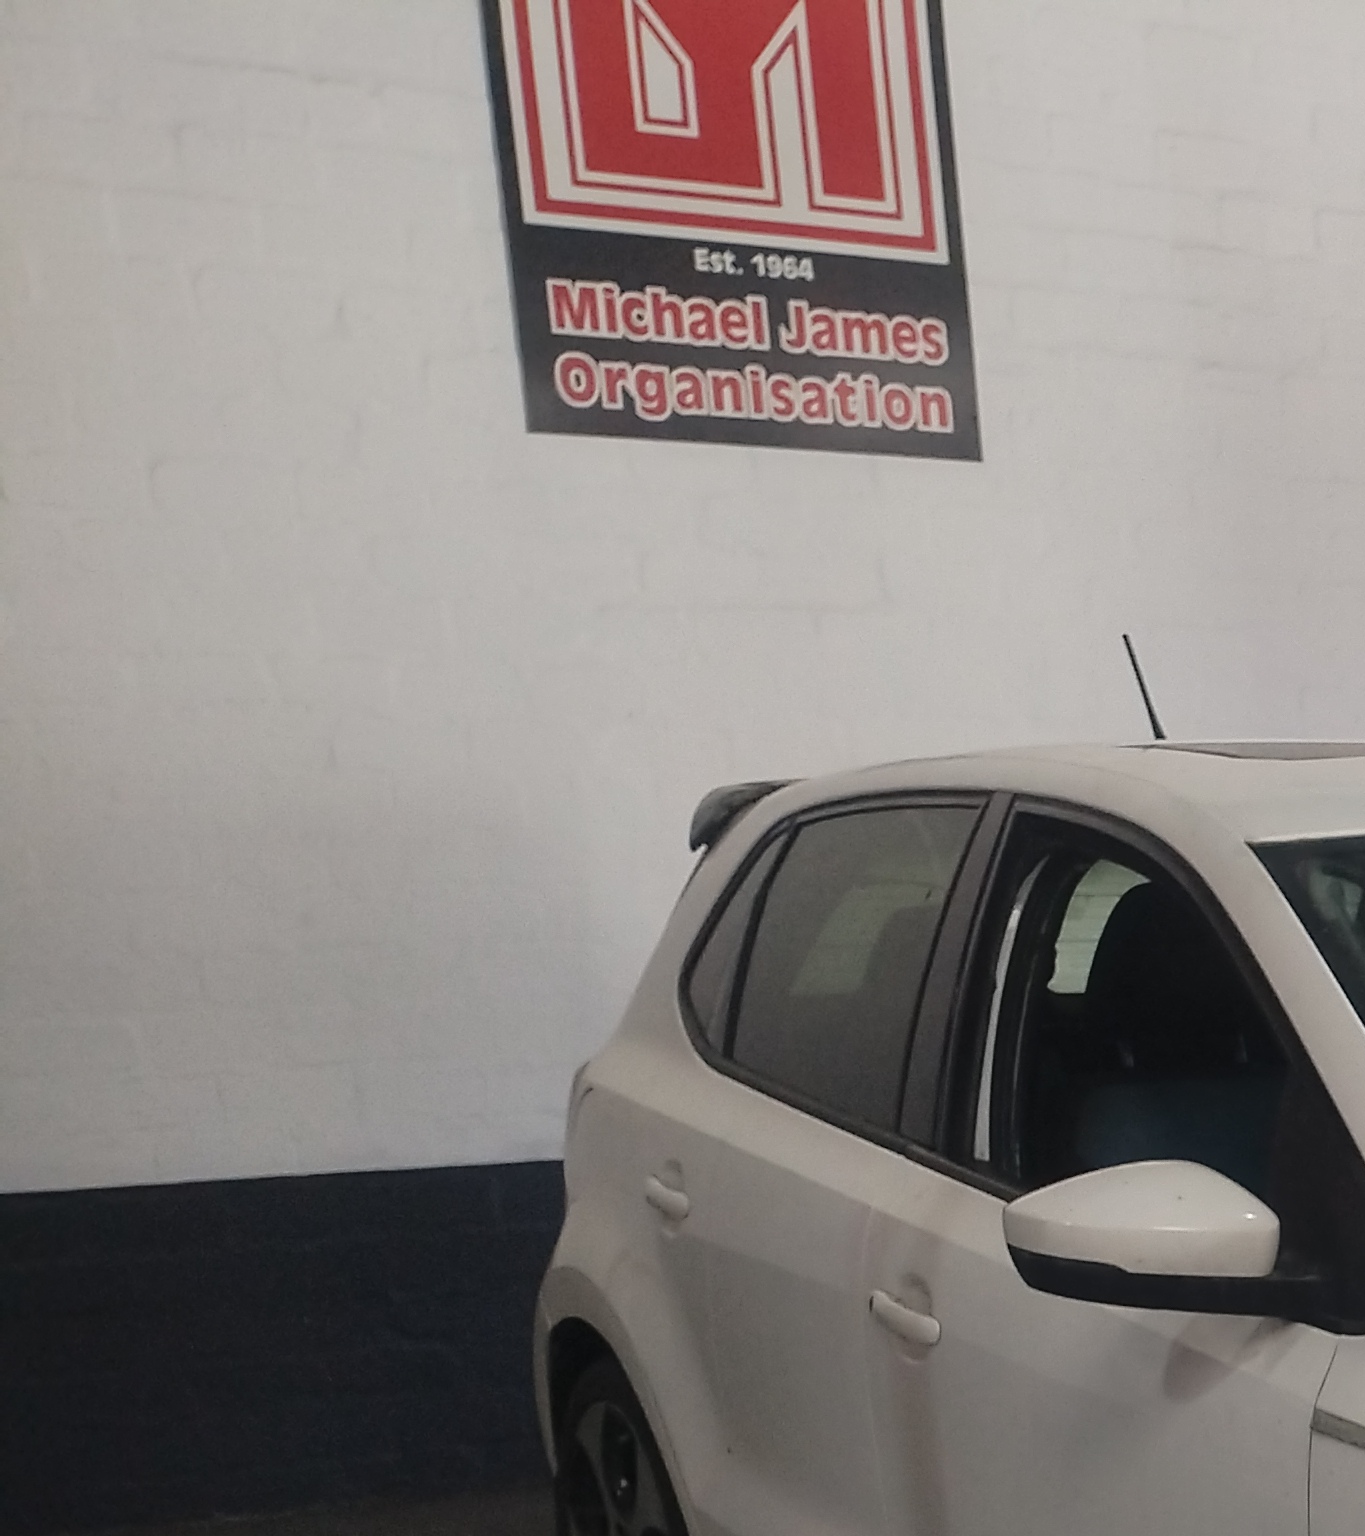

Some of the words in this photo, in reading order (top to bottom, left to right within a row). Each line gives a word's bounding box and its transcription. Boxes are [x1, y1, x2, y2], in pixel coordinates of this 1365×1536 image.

[694, 248, 744, 276] Est.
[750, 253, 814, 281] 1964
[546, 279, 770, 351] Michael
[778, 301, 948, 366] James
[554, 350, 954, 433] Organisation
